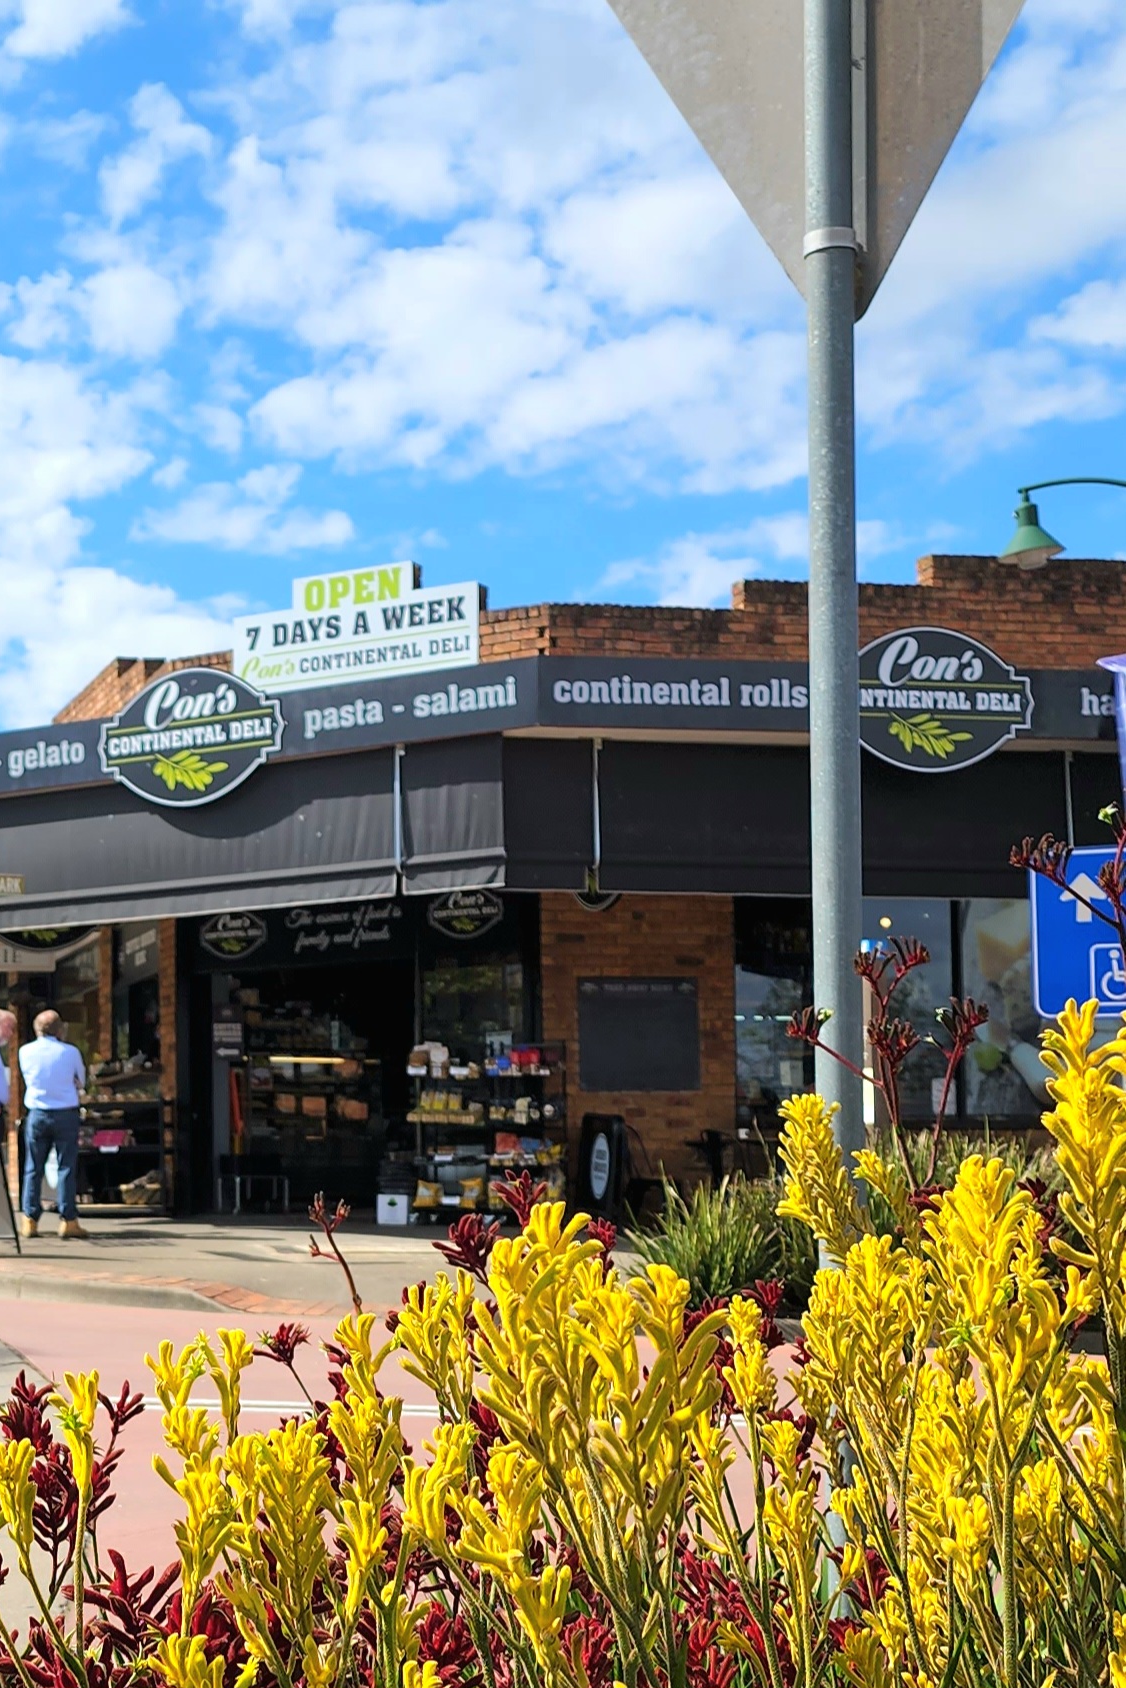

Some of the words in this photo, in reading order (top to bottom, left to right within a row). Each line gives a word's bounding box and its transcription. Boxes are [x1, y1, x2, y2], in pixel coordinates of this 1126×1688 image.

[303, 566, 402, 612] OPEN
[245, 626, 262, 651] 7
[272, 614, 342, 647] DAYS
[352, 611, 371, 635] A
[382, 596, 466, 631] WEEK
[240, 655, 296, 681] Con's
[299, 641, 423, 674] CONTINENTAL
[428, 635, 472, 656] DELI
[878, 637, 984, 687] Con's
[144, 680, 238, 731] Con's
[303, 698, 385, 740] pasta
[412, 676, 518, 718] salami
[552, 674, 731, 708] continental
[739, 678, 809, 709] rolls
[858, 688, 972, 711] NTINENTAL
[975, 692, 1022, 712] DELI
[7, 739, 86, 778] gelato
[107, 721, 227, 758] CONTINENTAL
[229, 717, 273, 741] DELI
